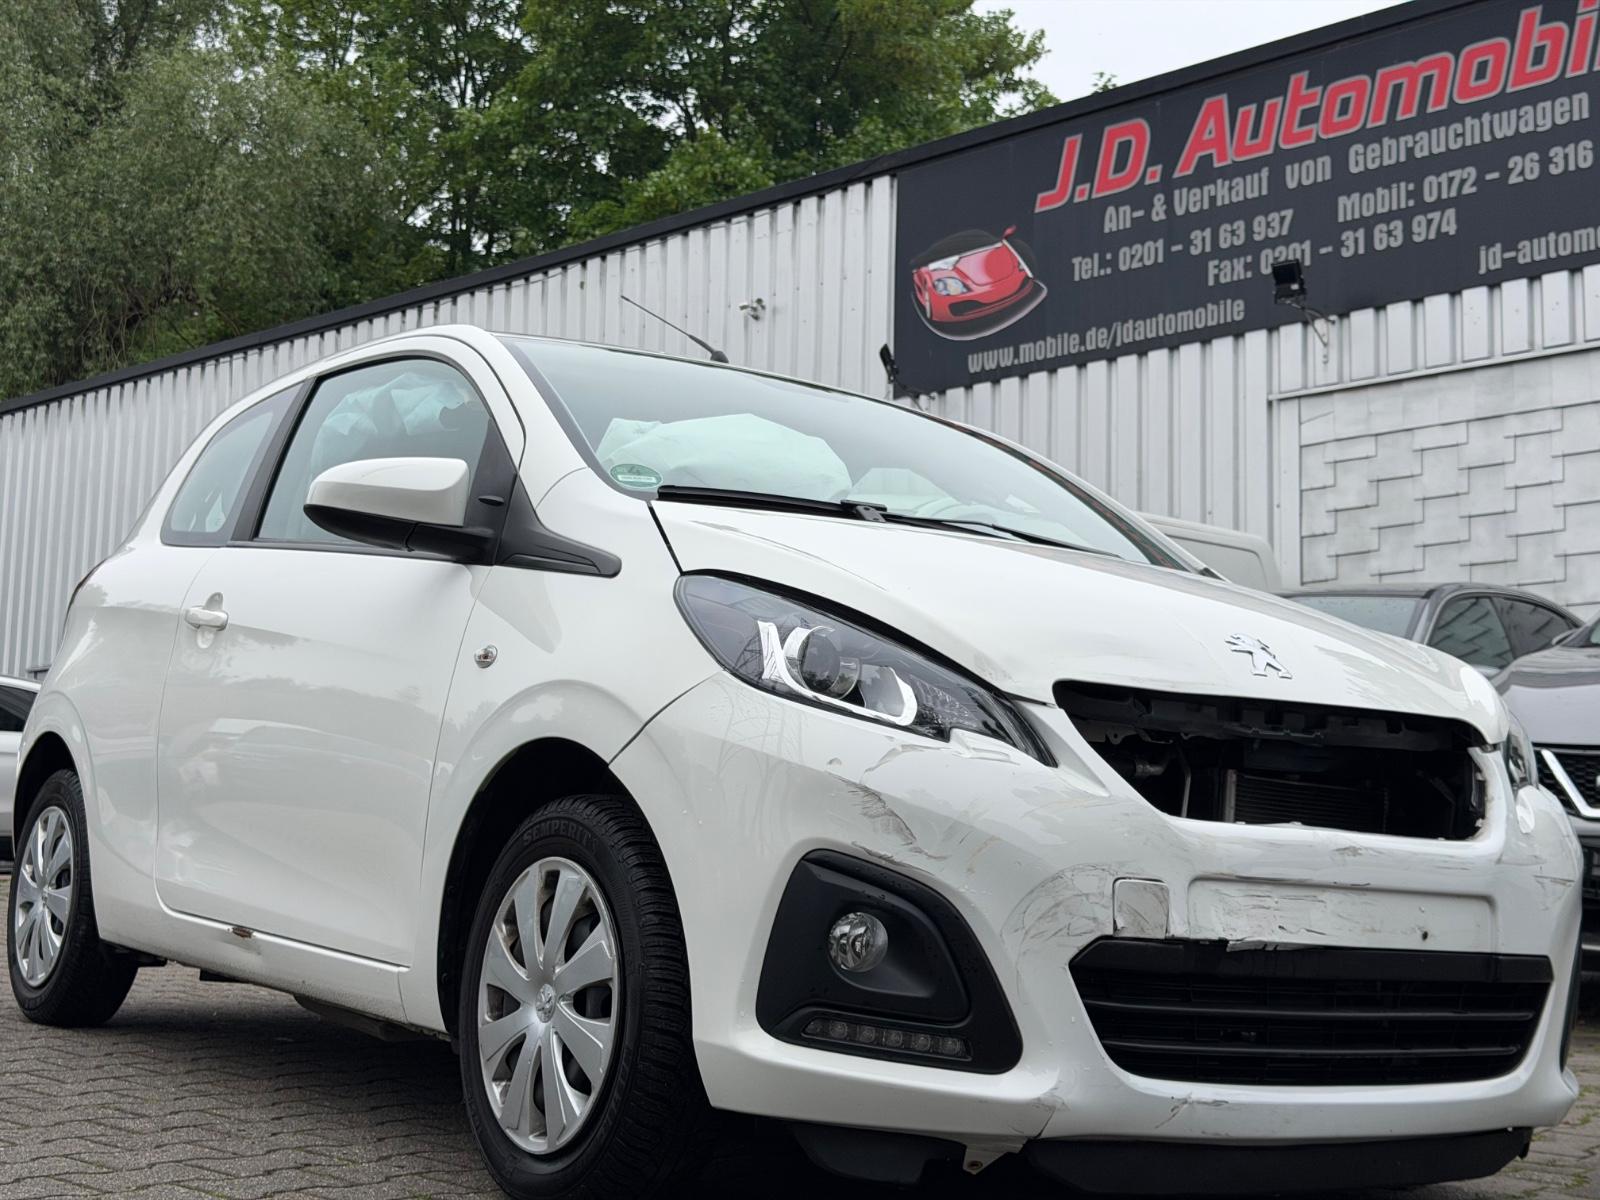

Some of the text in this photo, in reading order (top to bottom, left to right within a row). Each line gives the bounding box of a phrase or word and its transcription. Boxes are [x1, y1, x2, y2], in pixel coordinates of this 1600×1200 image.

[1034, 0, 1600, 213] J.D. Automobi
[1104, 91, 1590, 233] An- & Verkauf von Gebrauchtwagen
[1337, 181, 1415, 223] Mobil:
[1422, 166, 1478, 203] 0172
[1507, 151, 1540, 185] 26
[1548, 139, 1594, 175] 316
[1071, 252, 1112, 281] Tel.:
[1118, 238, 1164, 271] 0201
[1189, 227, 1212, 255] 31
[1219, 219, 1246, 249] 63
[1252, 208, 1294, 242] 937
[1207, 255, 1252, 287] Fax:
[1340, 227, 1366, 258] 31
[1373, 219, 1404, 251] 63
[1411, 207, 1458, 243] 974
[968, 299, 1245, 374] www.mobile.de/jdautomobile
[522, 818, 592, 847] SEMPERIT
